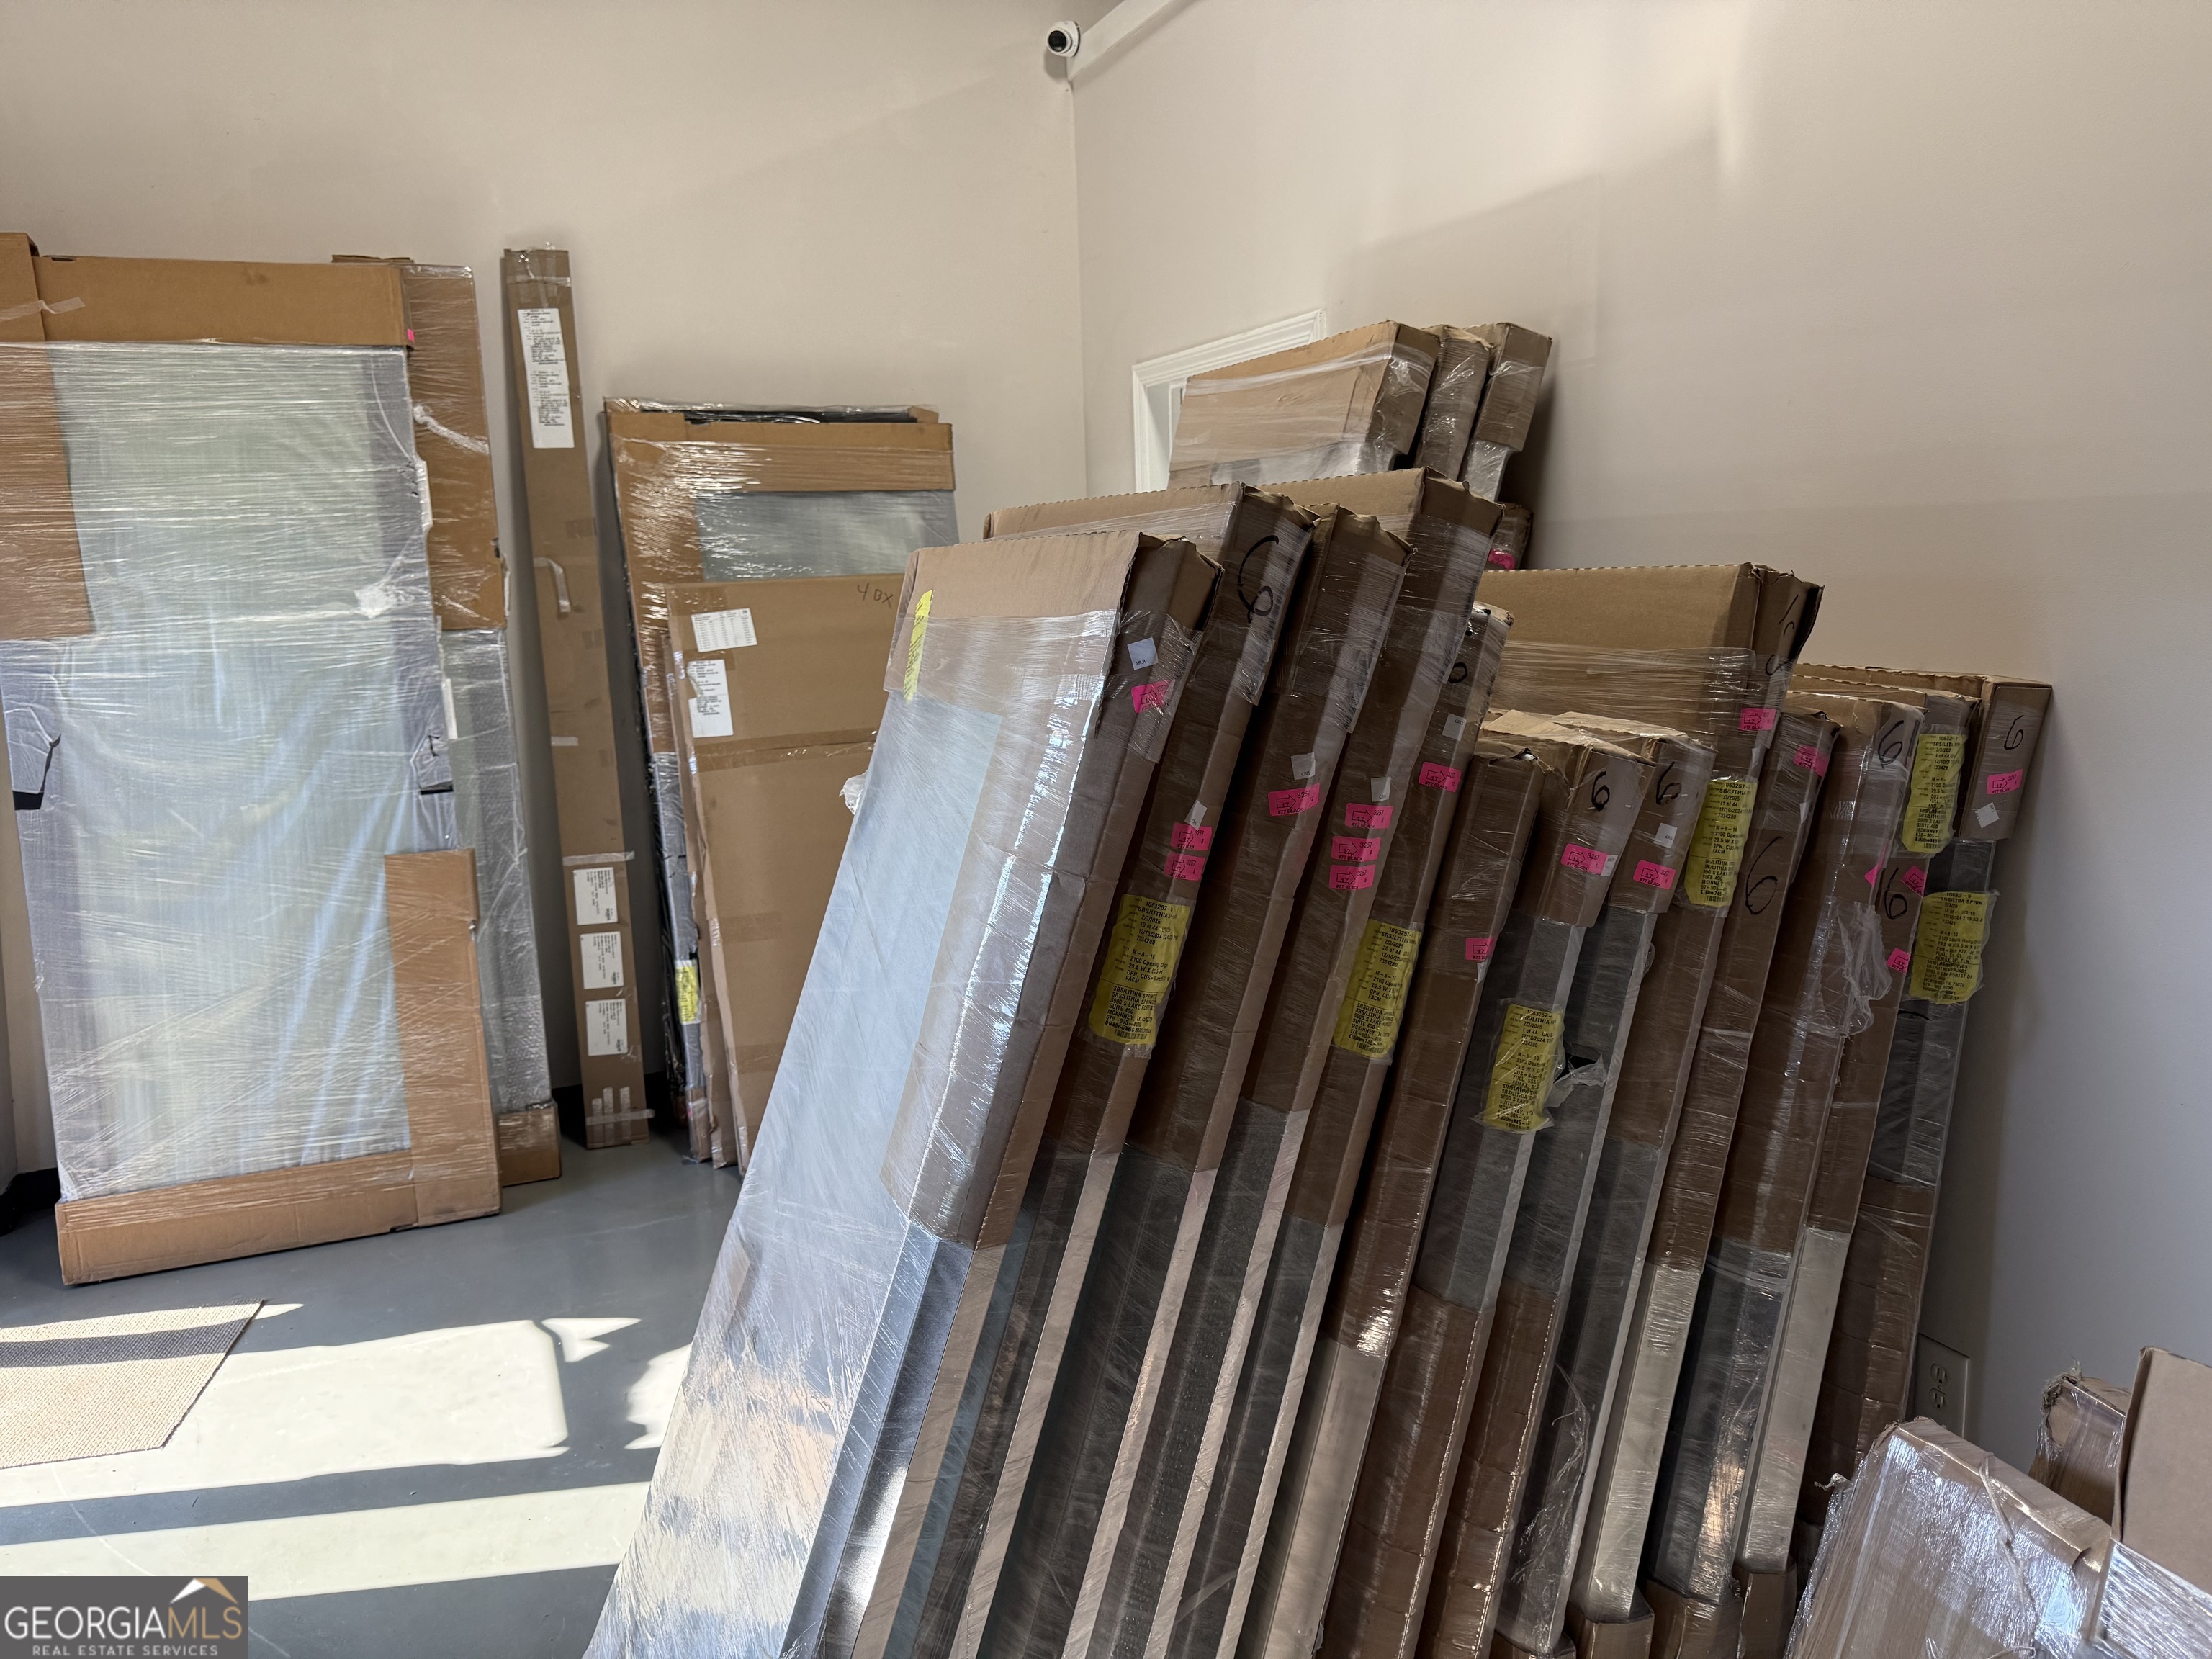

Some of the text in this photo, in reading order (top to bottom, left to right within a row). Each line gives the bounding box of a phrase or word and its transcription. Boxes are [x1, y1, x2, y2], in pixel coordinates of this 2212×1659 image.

[857, 583, 869, 601] 4
[1878, 720, 1904, 769] 6
[2004, 715, 2024, 750] 6
[1591, 771, 1609, 811] 6
[1656, 761, 1681, 806] 6
[1745, 836, 1783, 915] 6
[1884, 867, 1907, 919] 6
